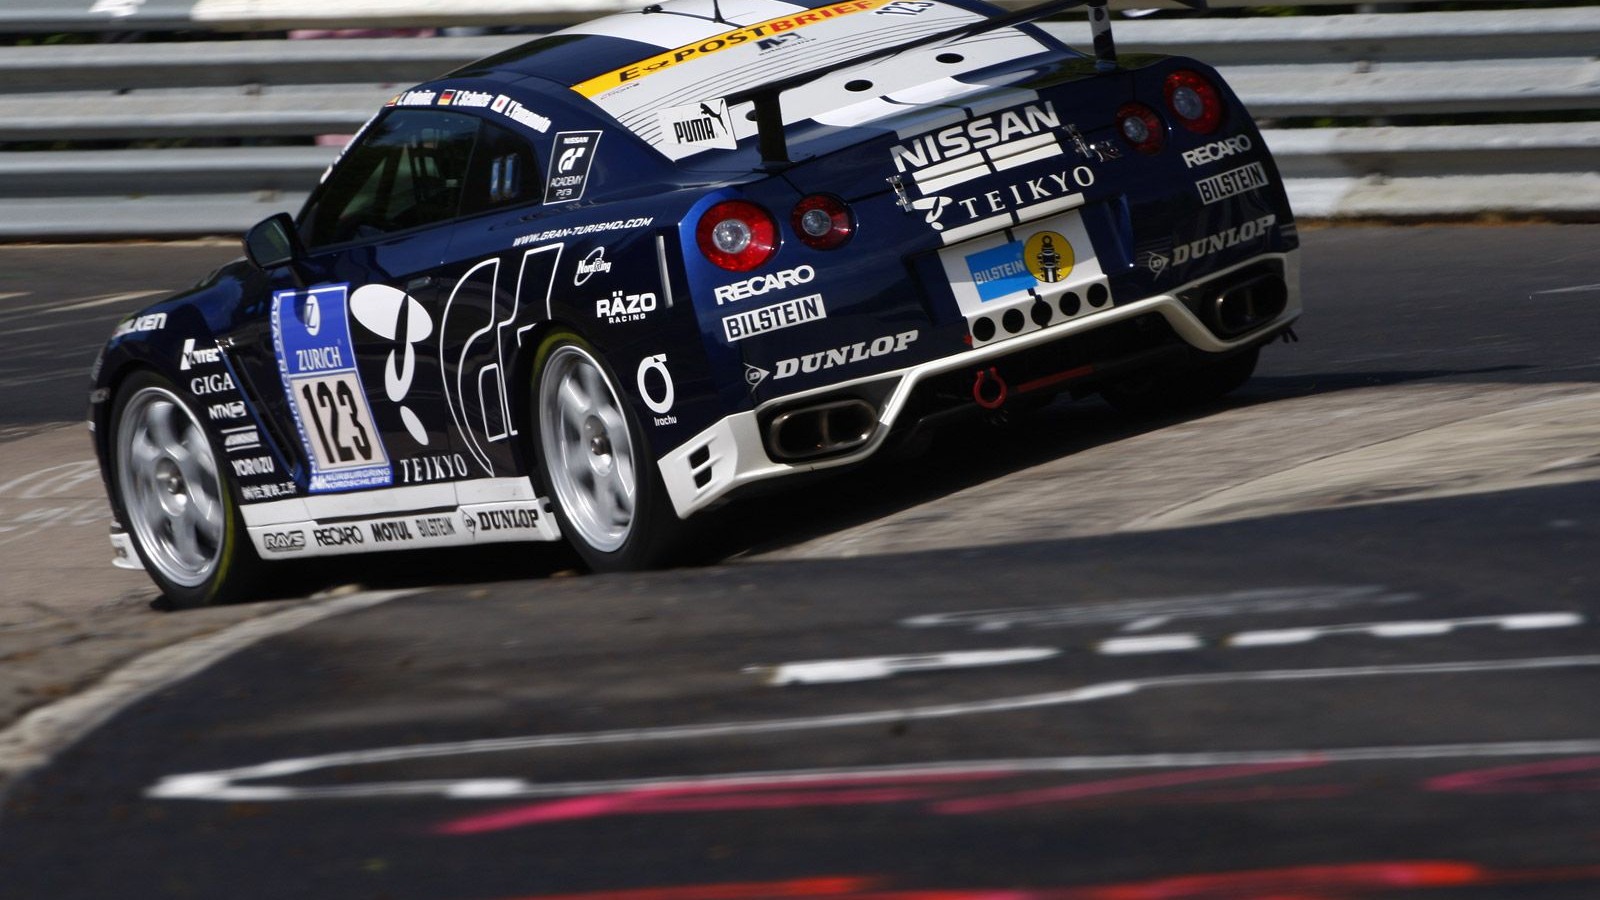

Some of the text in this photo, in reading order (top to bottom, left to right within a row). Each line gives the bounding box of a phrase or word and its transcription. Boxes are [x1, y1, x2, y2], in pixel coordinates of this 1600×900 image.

[876, 1, 935, 15] 123
[563, 136, 589, 144] NISSAN
[673, 117, 715, 144] PUMA
[889, 101, 1061, 173] NISSAN
[1181, 134, 1252, 168] RECARO
[550, 174, 584, 187] ACADEMY
[556, 188, 573, 197] PS3
[959, 166, 1095, 219] TEIKYO
[1199, 164, 1264, 203] BILSTEIN
[512, 217, 653, 247] WWW.GRAN-TURISMO.COM
[1172, 214, 1276, 266] DUNLOP
[714, 264, 815, 305] RECARO
[973, 259, 1026, 285] BILSTEIN
[596, 290, 657, 318] RÄZO
[609, 313, 646, 324] RACING
[726, 300, 821, 340] BILSTEIN
[296, 346, 342, 371] ZURICH
[773, 329, 919, 380] DUNLOP
[190, 372, 236, 396] GIGA
[302, 380, 372, 464] 123
[231, 456, 275, 477] YOROZU
[400, 453, 468, 483] TEIKYO
[371, 520, 414, 542] MOTUL
[416, 516, 456, 538] BILSTEIN
[477, 509, 540, 531] DUNLOP
[263, 530, 306, 552] RAYS
[313, 526, 364, 546] RECARO
